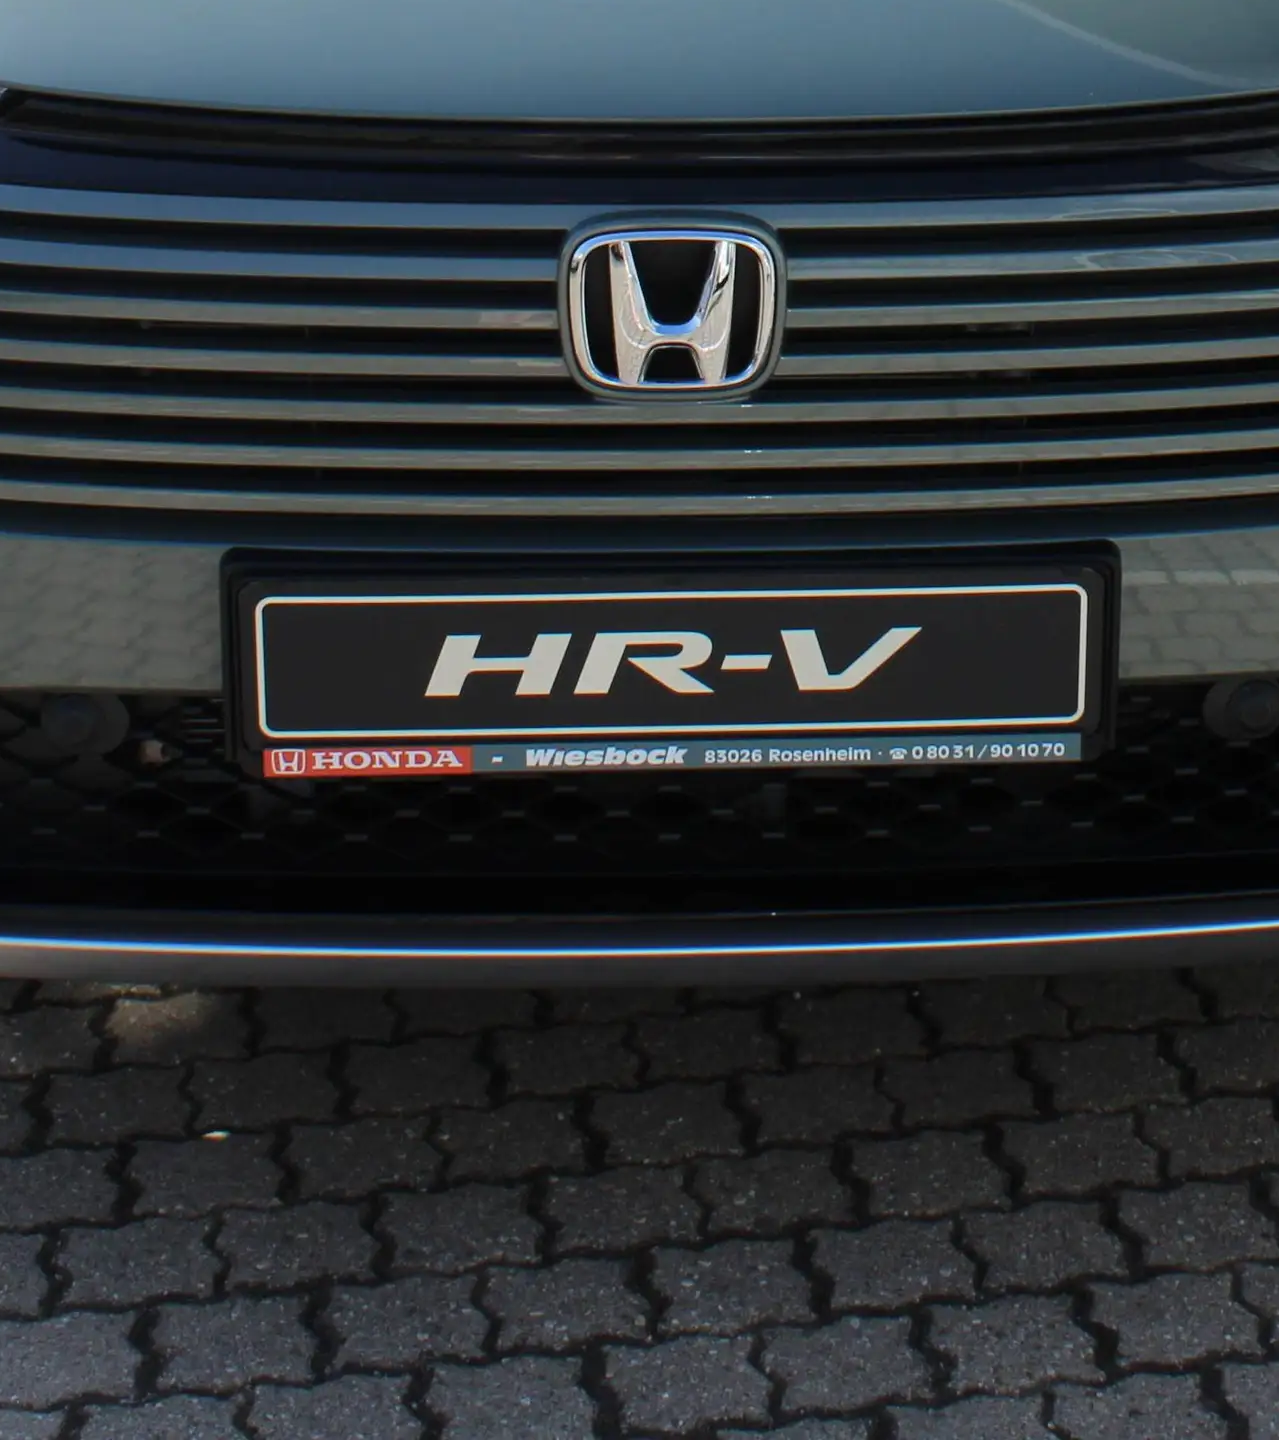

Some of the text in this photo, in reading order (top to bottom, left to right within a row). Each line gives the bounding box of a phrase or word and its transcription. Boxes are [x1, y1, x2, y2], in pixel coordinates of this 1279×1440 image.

[425, 627, 922, 697] HR-V
[312, 750, 463, 770] HONDA
[704, 748, 763, 764] 83026
[768, 746, 872, 763] Rosenheim
